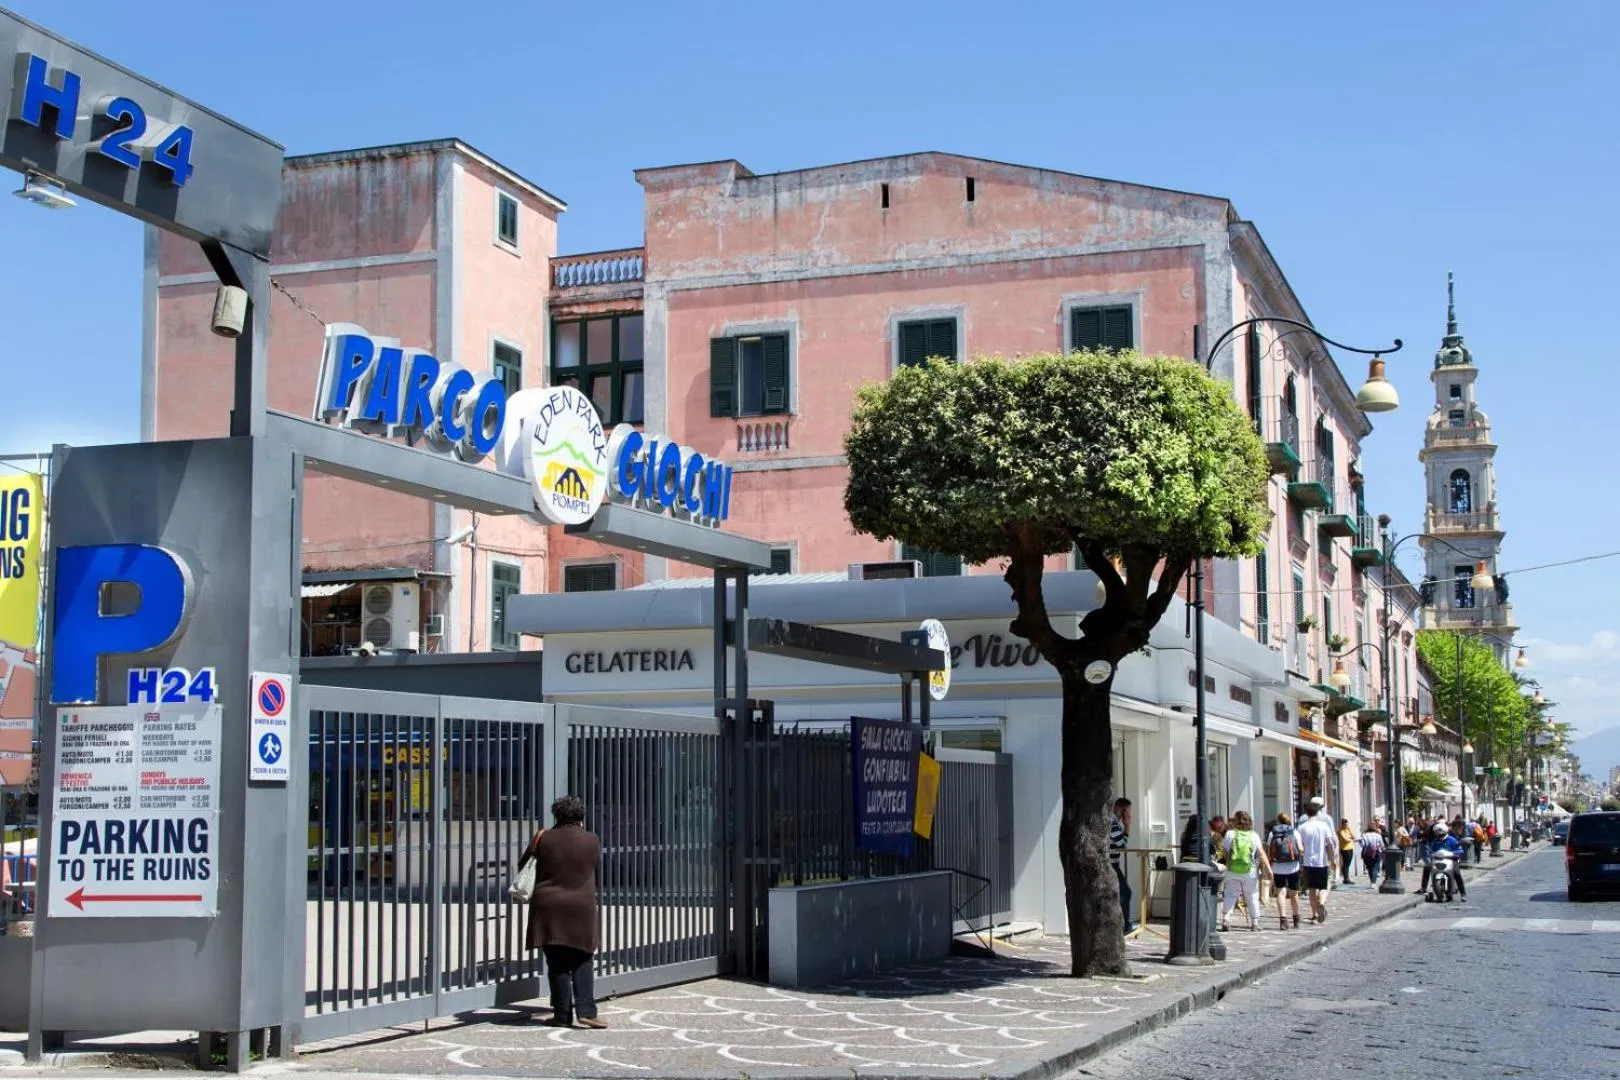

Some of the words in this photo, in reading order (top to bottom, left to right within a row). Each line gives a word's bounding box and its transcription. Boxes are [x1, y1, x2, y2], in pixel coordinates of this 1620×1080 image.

[330, 334, 507, 456] PARCO
[534, 390, 572, 445] EDEN
[576, 396, 607, 465] PARK
[617, 430, 733, 521] GIOCHI
[552, 494, 591, 515] POMPEI
[52, 542, 187, 704] P
[565, 649, 695, 674] GELATERIA
[964, 634, 1041, 668] Vivo
[127, 667, 215, 704] H24
[883, 727, 913, 753] GIOCHI
[863, 757, 911, 783] GONFIABILI
[866, 789, 907, 814] LUDOTECA
[59, 817, 209, 855] PARKING
[58, 858, 86, 882] TO
[93, 858, 135, 882] THE
[143, 857, 211, 881] RUINS
